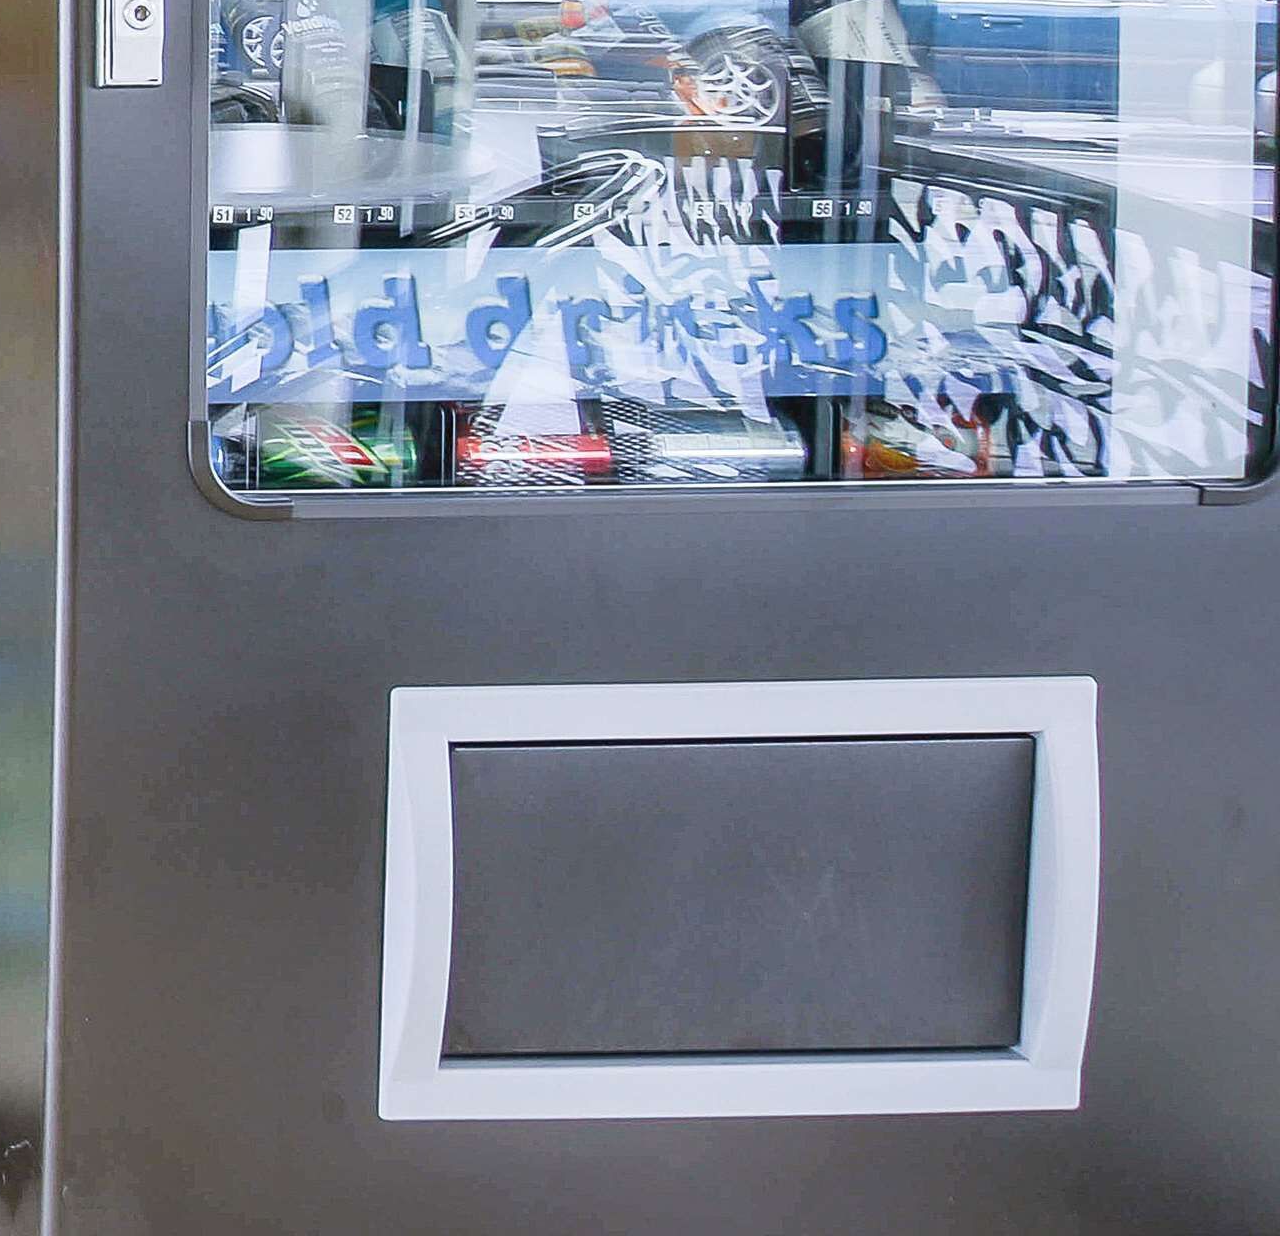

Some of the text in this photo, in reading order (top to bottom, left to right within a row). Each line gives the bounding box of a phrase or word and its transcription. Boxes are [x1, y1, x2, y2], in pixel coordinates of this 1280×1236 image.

[215, 208, 231, 222] 51
[336, 207, 353, 222] 52
[814, 201, 831, 217] 56
